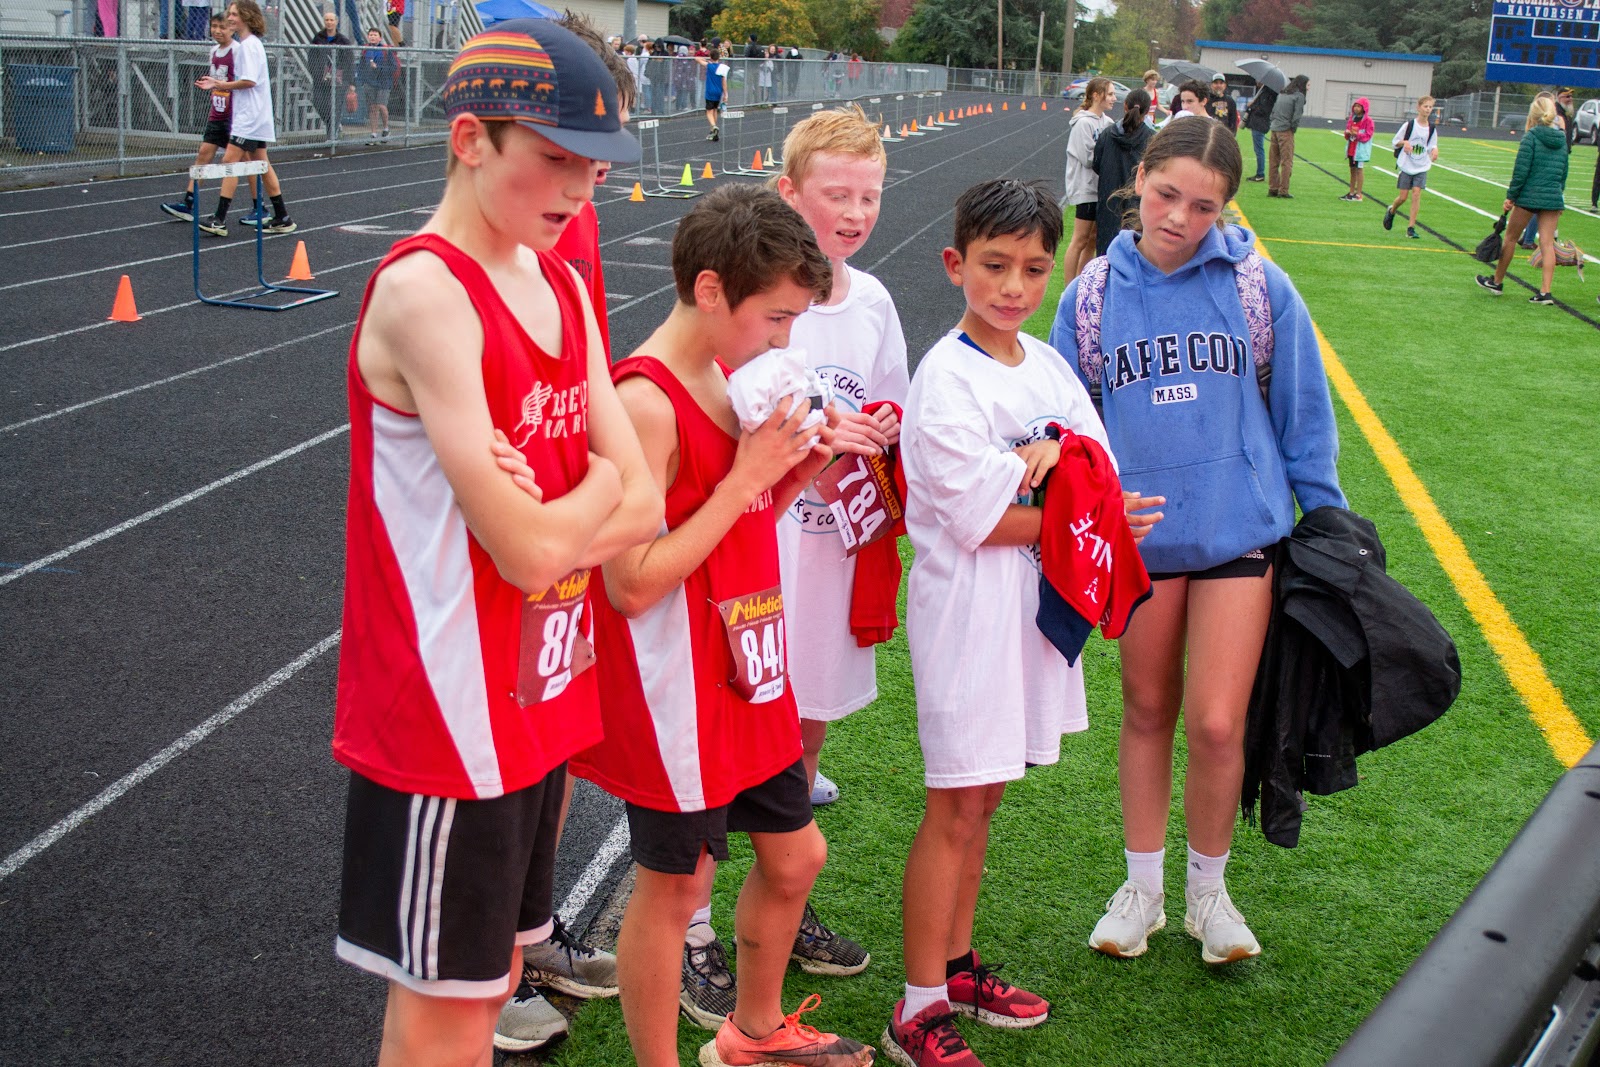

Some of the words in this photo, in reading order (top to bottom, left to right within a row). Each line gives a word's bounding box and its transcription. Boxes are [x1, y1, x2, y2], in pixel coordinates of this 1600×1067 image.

[1507, 4, 1584, 20] HALVORSEN
[1102, 333, 1182, 394] CAPE
[1155, 387, 1194, 402] MASS.
[868, 452, 894, 499] thletic
[837, 455, 887, 547] 784
